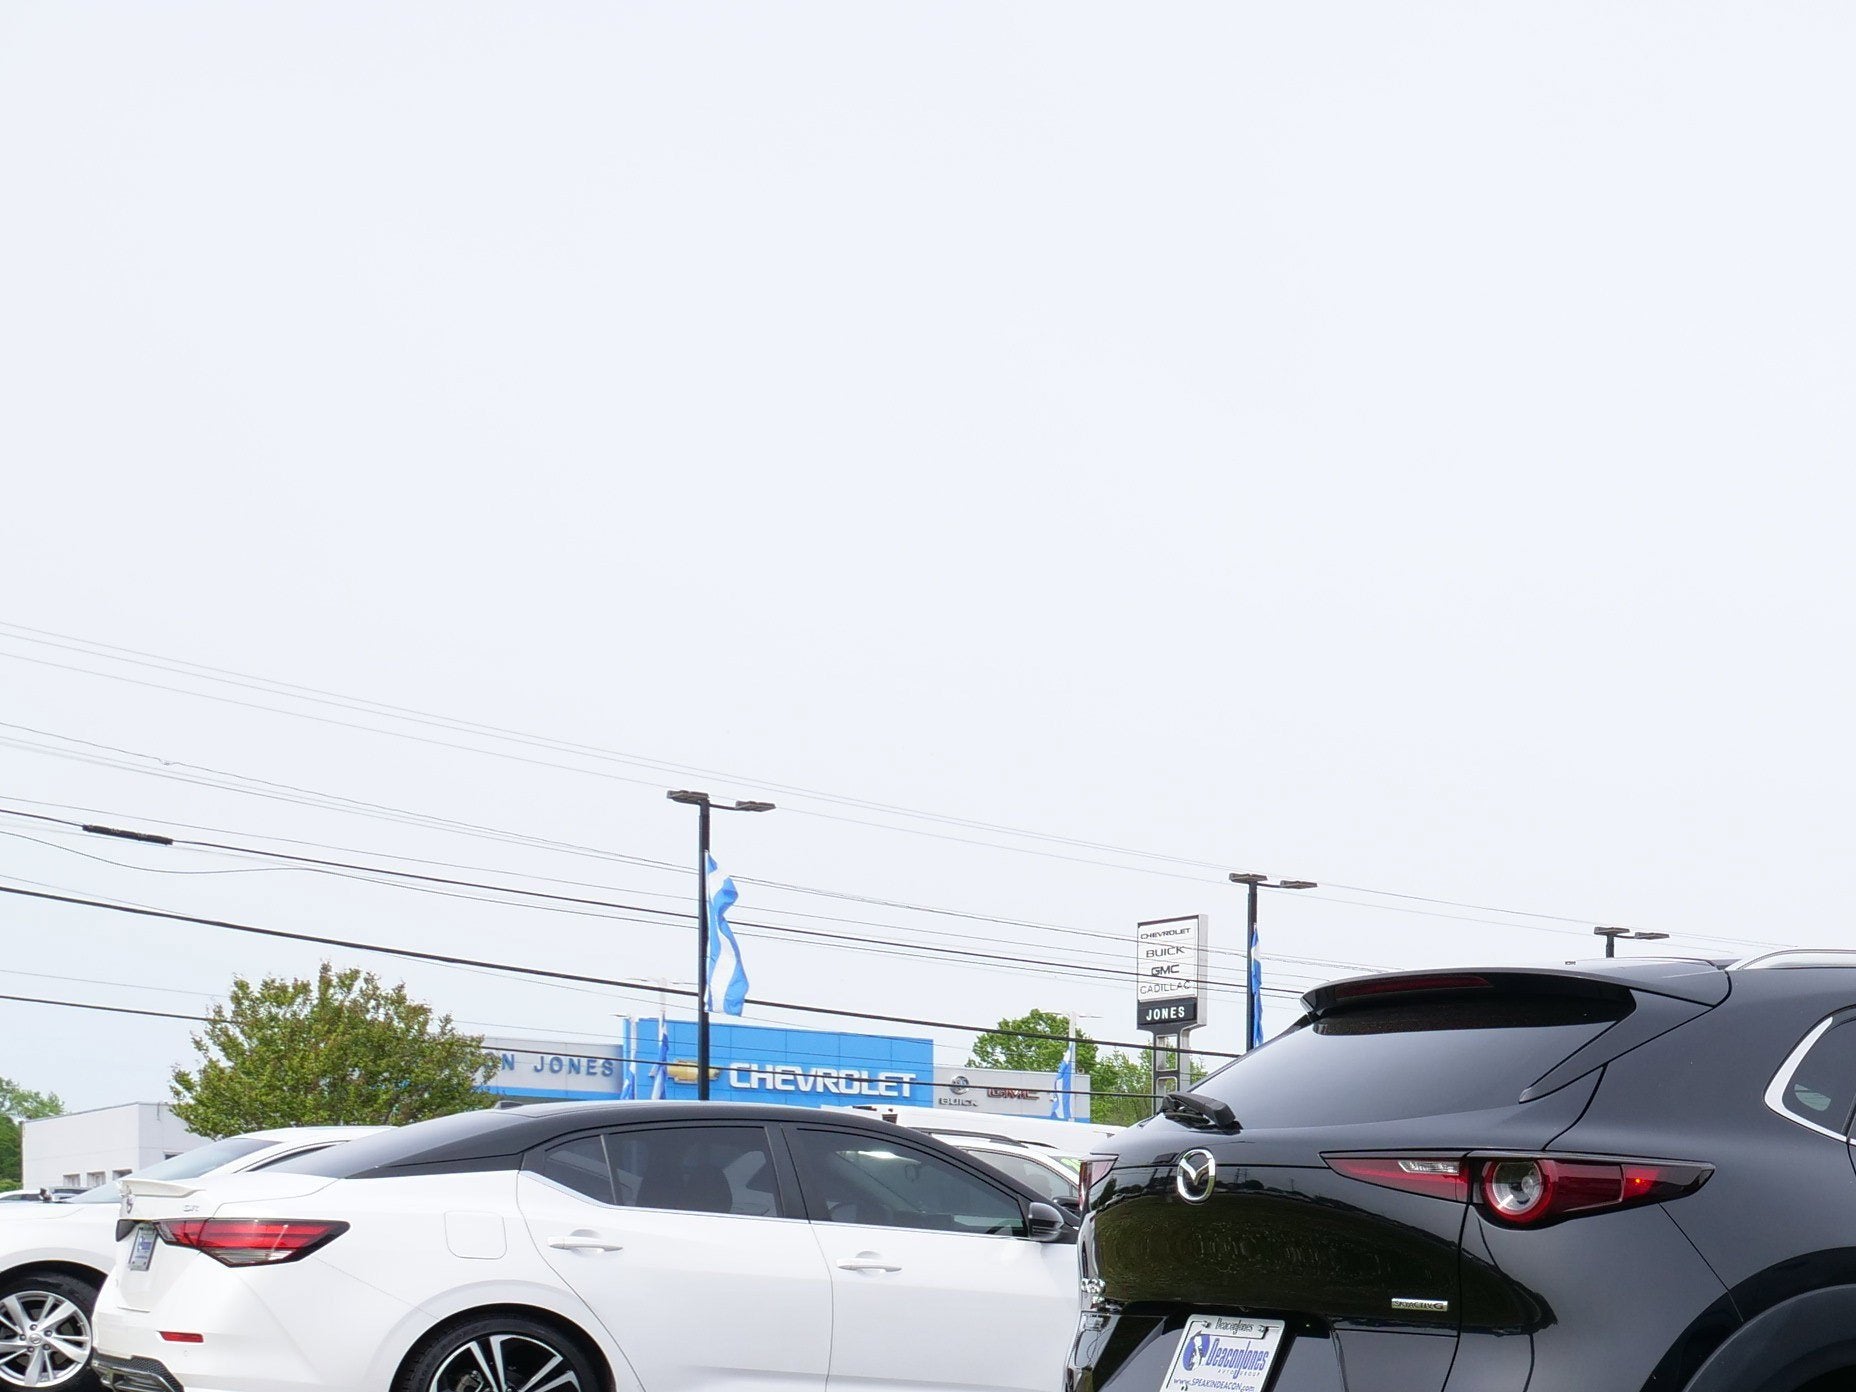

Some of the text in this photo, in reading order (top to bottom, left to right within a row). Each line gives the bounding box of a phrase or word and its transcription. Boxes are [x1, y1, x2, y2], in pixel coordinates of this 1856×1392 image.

[1140, 928, 1191, 940] CHEVROLET
[1146, 945, 1185, 958] BUICK
[1151, 964, 1180, 977] GMC
[1140, 980, 1192, 994] CADILLAC
[1146, 1006, 1185, 1021] JONES
[533, 1056, 615, 1078] JONES
[729, 1062, 916, 1098] CHEVROLET
[939, 1096, 979, 1107] BUICK
